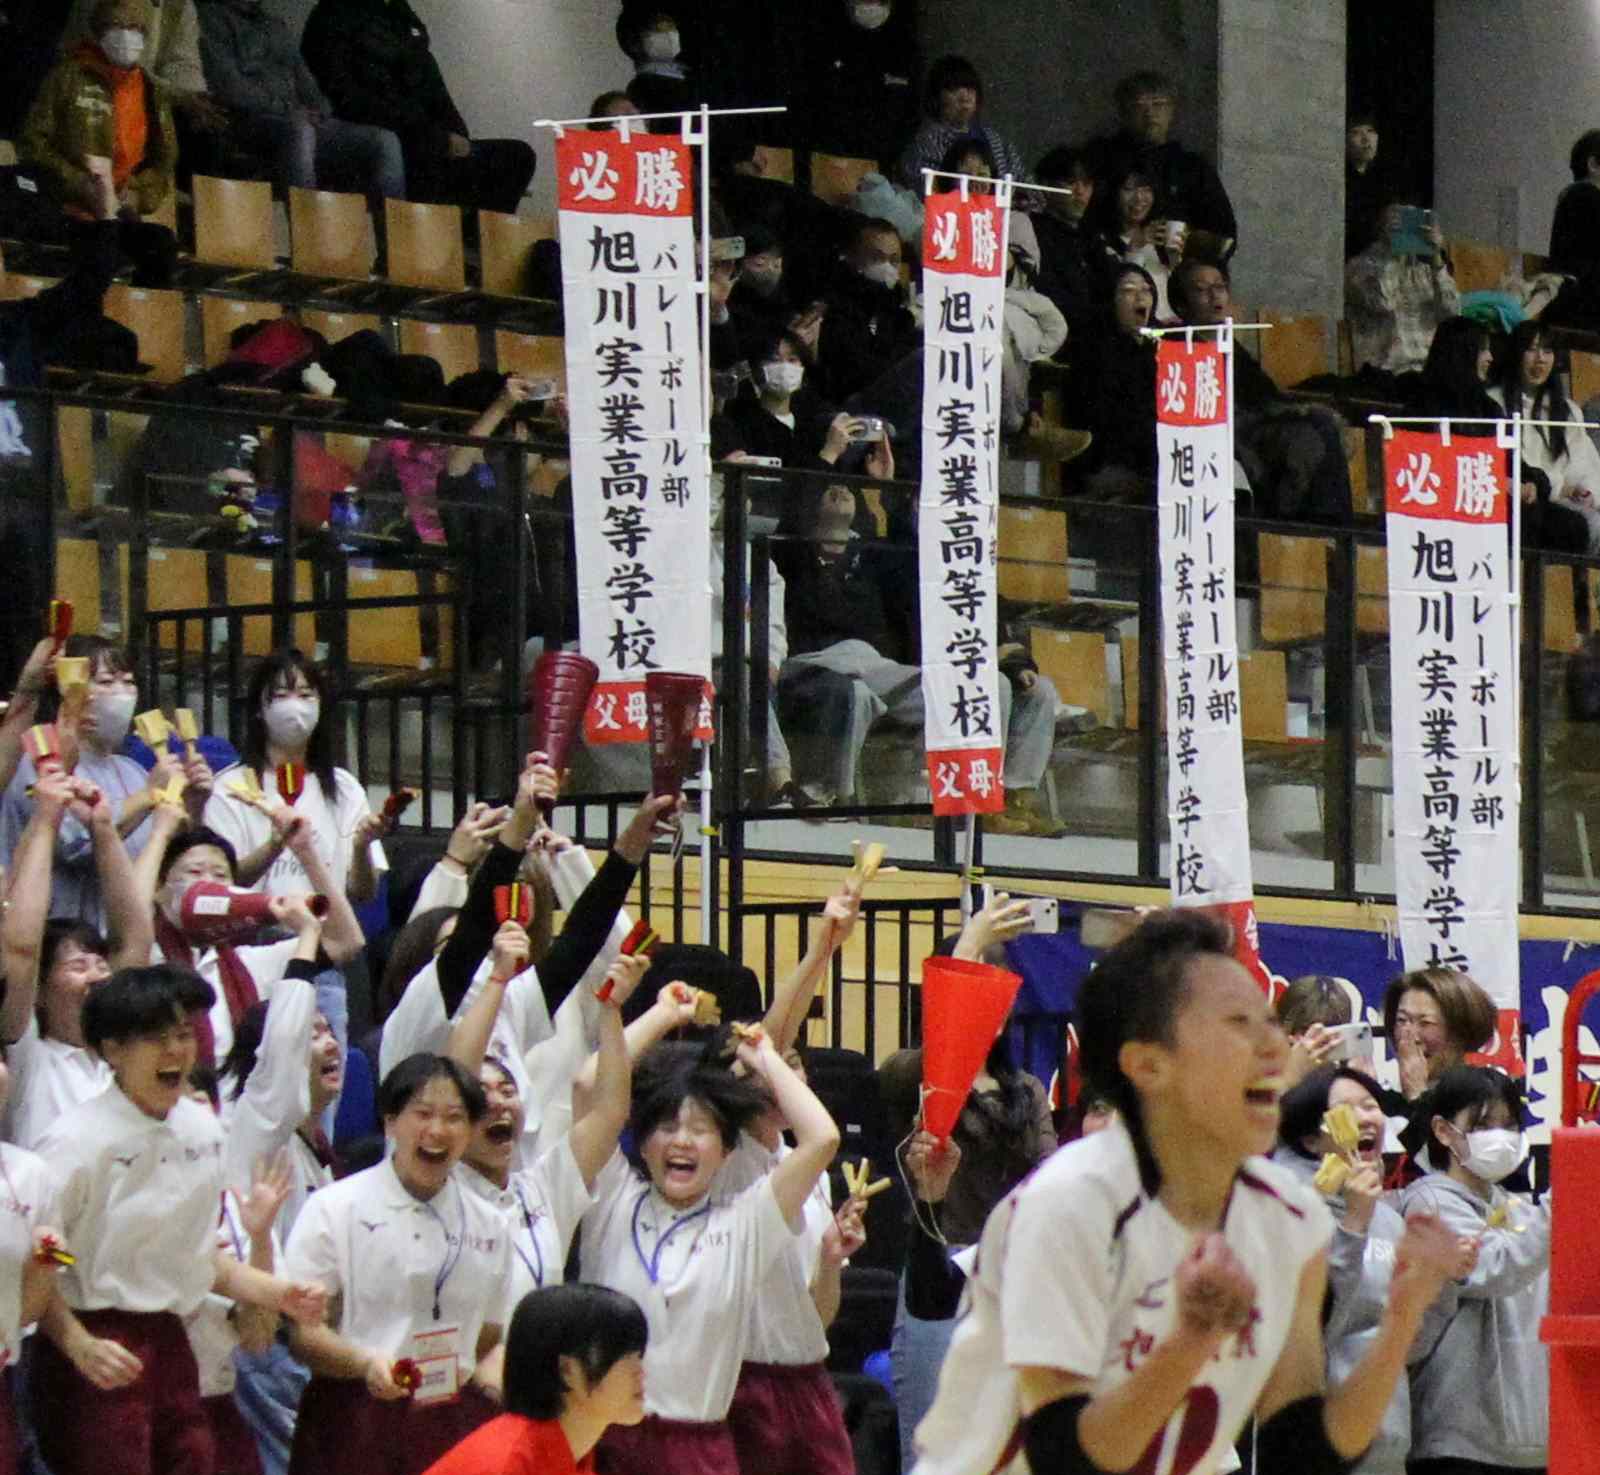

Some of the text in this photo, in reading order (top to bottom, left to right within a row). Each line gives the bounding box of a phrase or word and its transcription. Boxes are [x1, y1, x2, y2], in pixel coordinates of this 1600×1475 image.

[569, 146, 686, 213] 必勝
[932, 208, 999, 271] 必勝
[587, 225, 660, 670] 旭川実業高等学校
[652, 244, 691, 509] バレーボール部
[1160, 356, 1222, 420] 必勝
[1394, 452, 1501, 518] 必勝
[936, 286, 992, 738] 旭川実業高等学校
[1201, 450, 1239, 726] バレーボール部
[936, 758, 1004, 799] 父母
[1170, 438, 1211, 896] 旭川実業高等学校
[1468, 554, 1506, 830] バレーボール部
